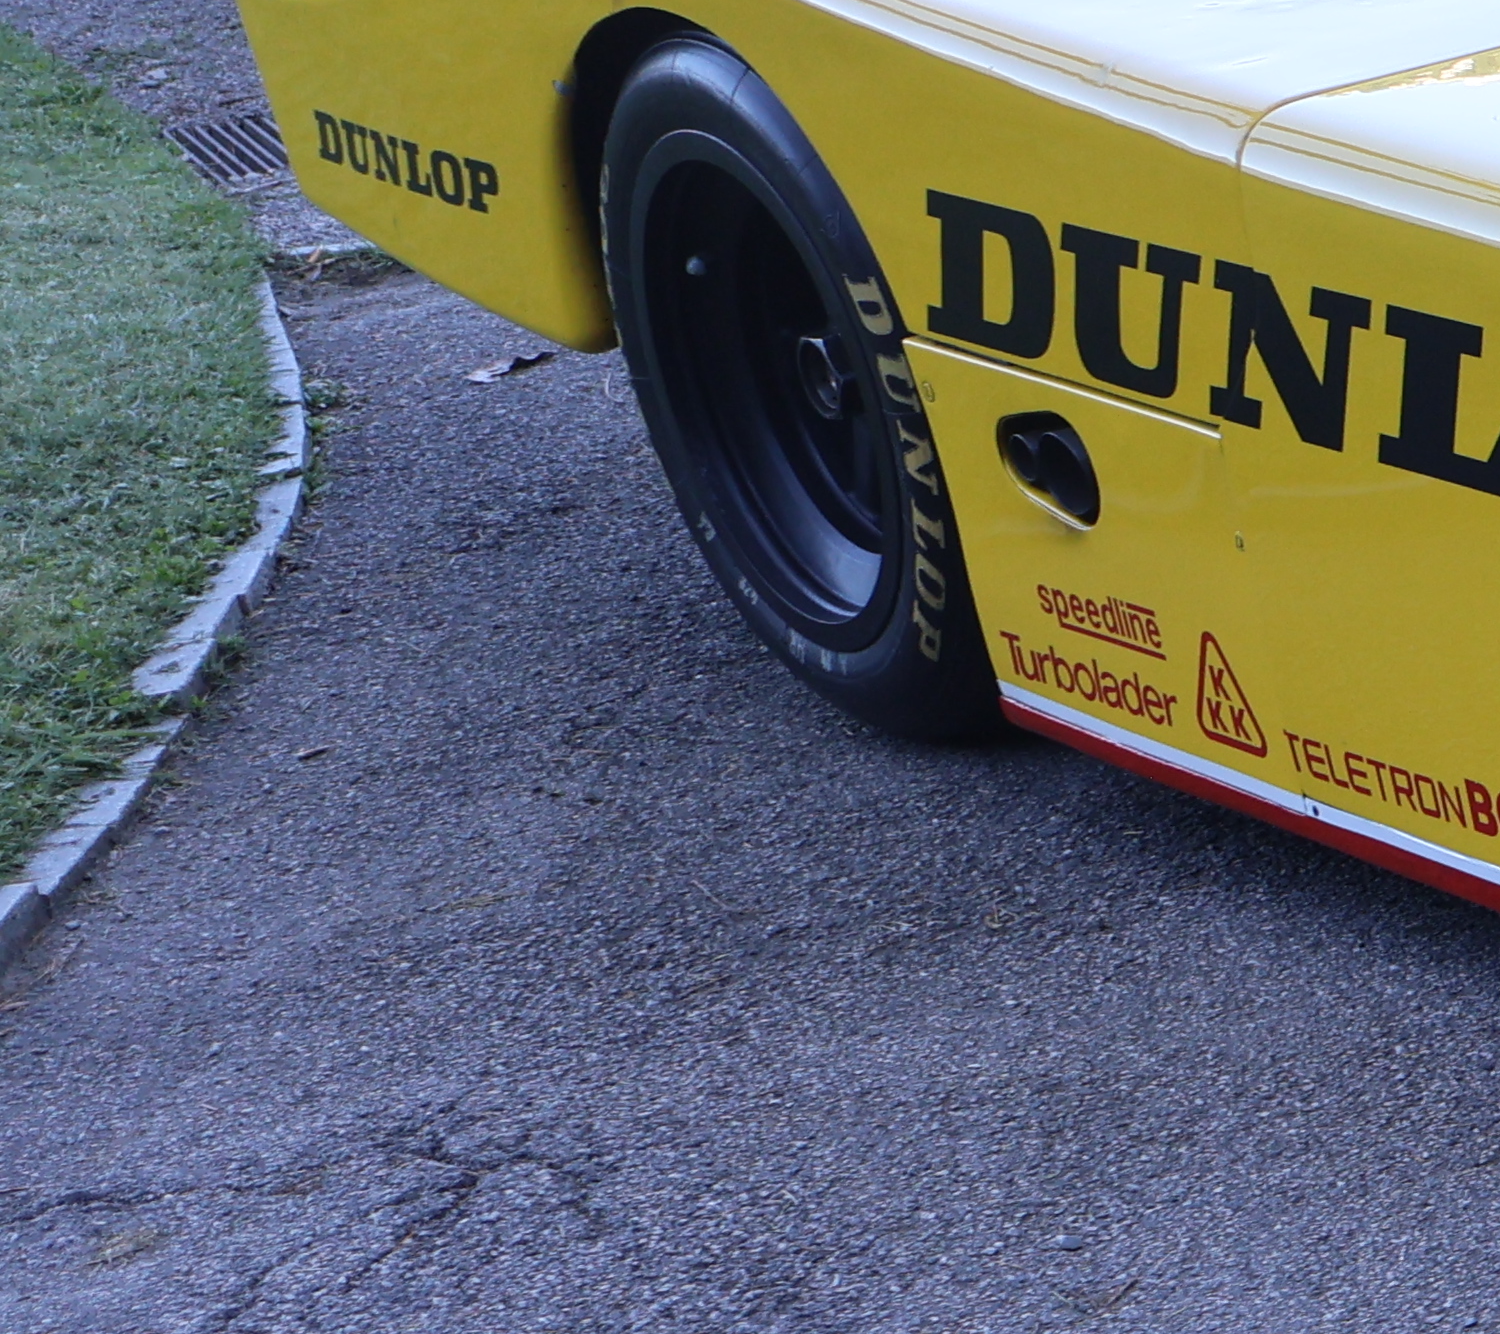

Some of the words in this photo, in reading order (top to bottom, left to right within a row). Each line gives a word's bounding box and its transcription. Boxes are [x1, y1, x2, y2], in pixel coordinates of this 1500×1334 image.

[313, 109, 498, 214] DUNLOP
[842, 273, 946, 663] DUNLOP
[1036, 583, 1165, 657] speedline
[998, 629, 1178, 727] Turbolader
[1284, 729, 1467, 828] TELETRON
